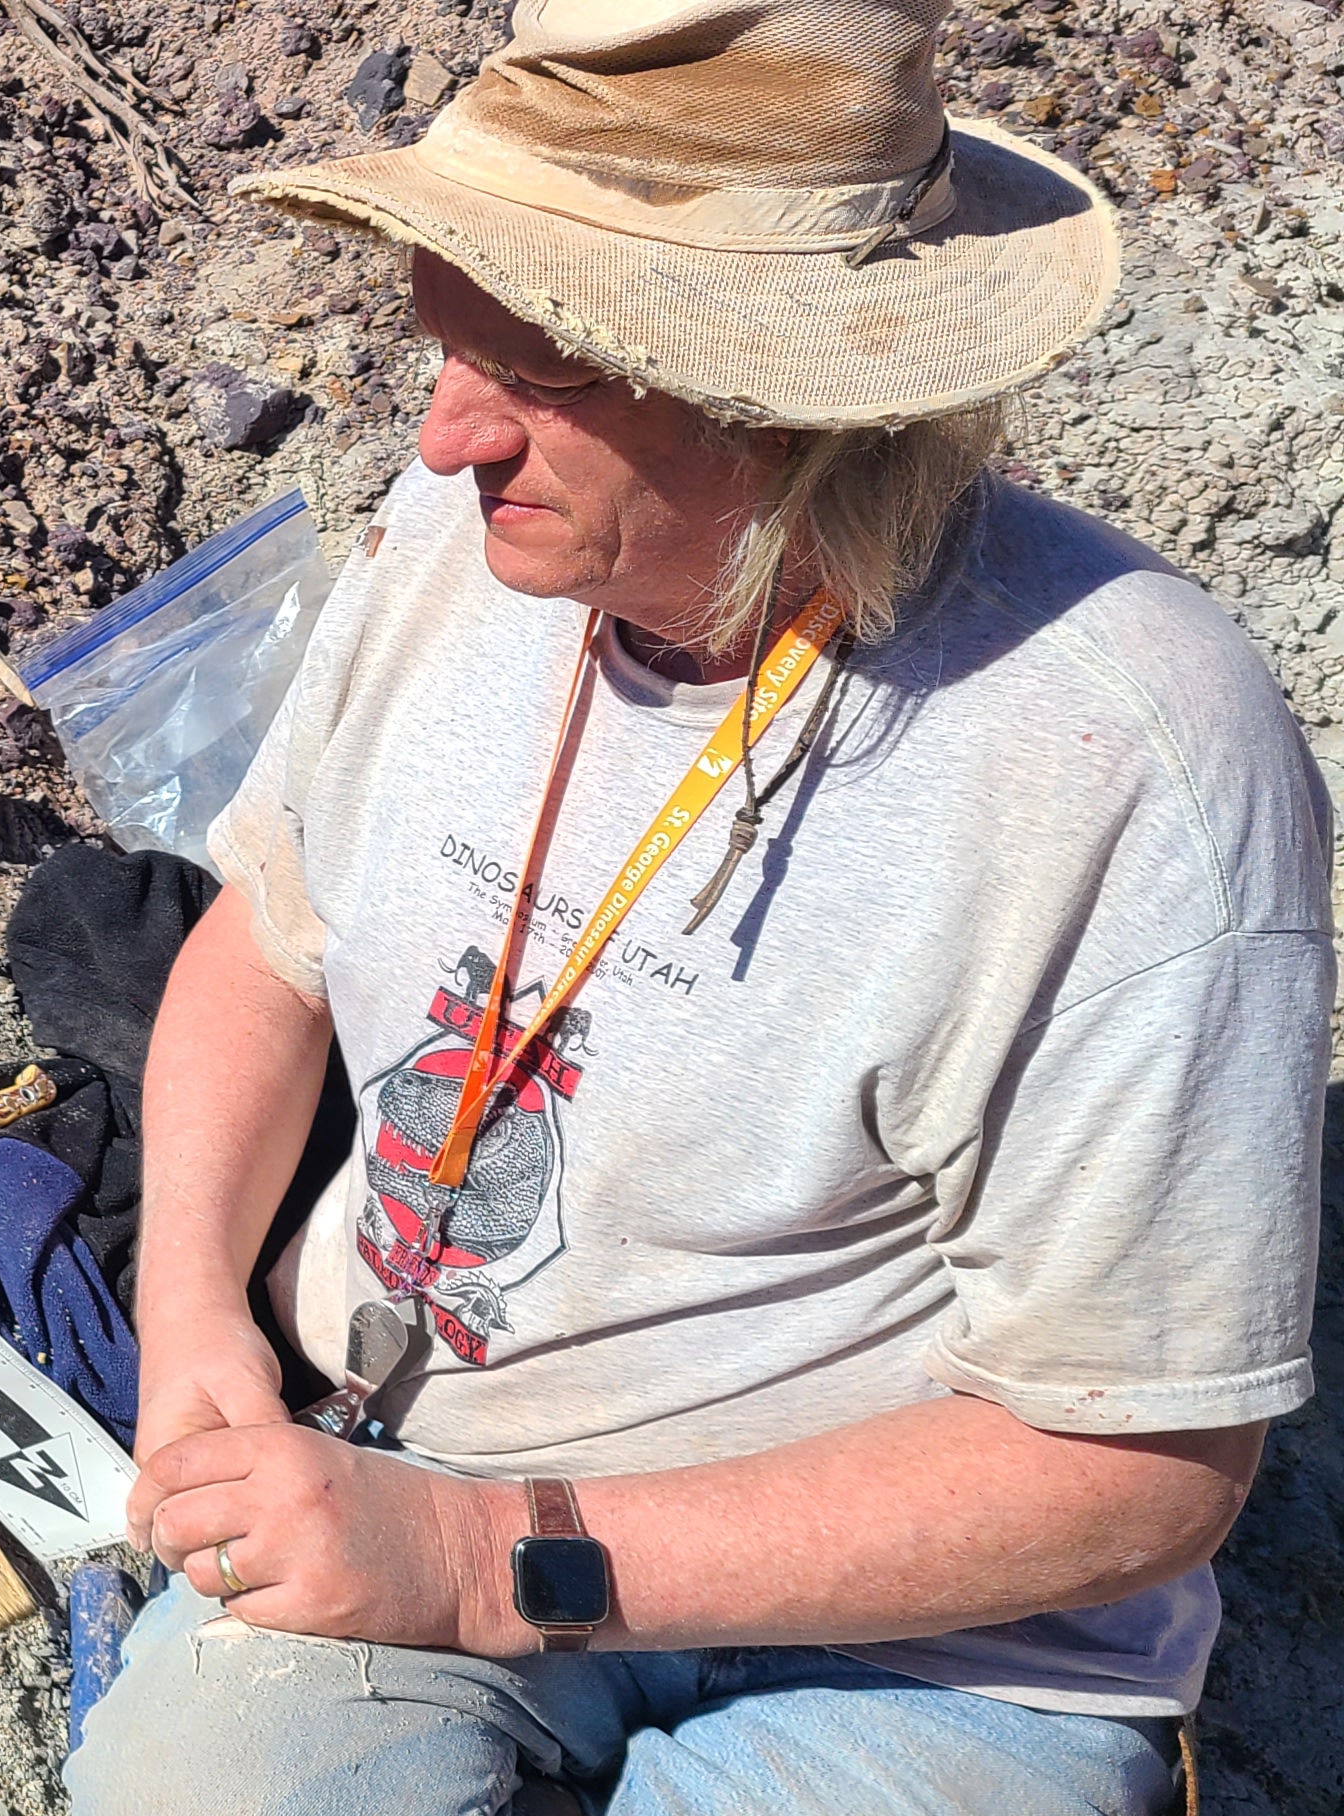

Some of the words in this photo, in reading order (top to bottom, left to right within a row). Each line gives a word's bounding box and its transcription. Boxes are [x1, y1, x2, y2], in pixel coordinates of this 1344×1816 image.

[766, 603, 840, 687] Discovery
[662, 805, 691, 828] St.
[621, 831, 671, 891] George
[440, 834, 585, 929] DINOSAURS
[621, 940, 700, 995] UTAH
[467, 881, 487, 899] The
[489, 895, 547, 931] Symosium
[612, 966, 633, 985] Utah
[492, 910, 510, 926] Ma
[574, 892, 628, 966] Dinosaur
[60, 1482, 71, 1493] 10
[70, 1491, 83, 1504] CM
